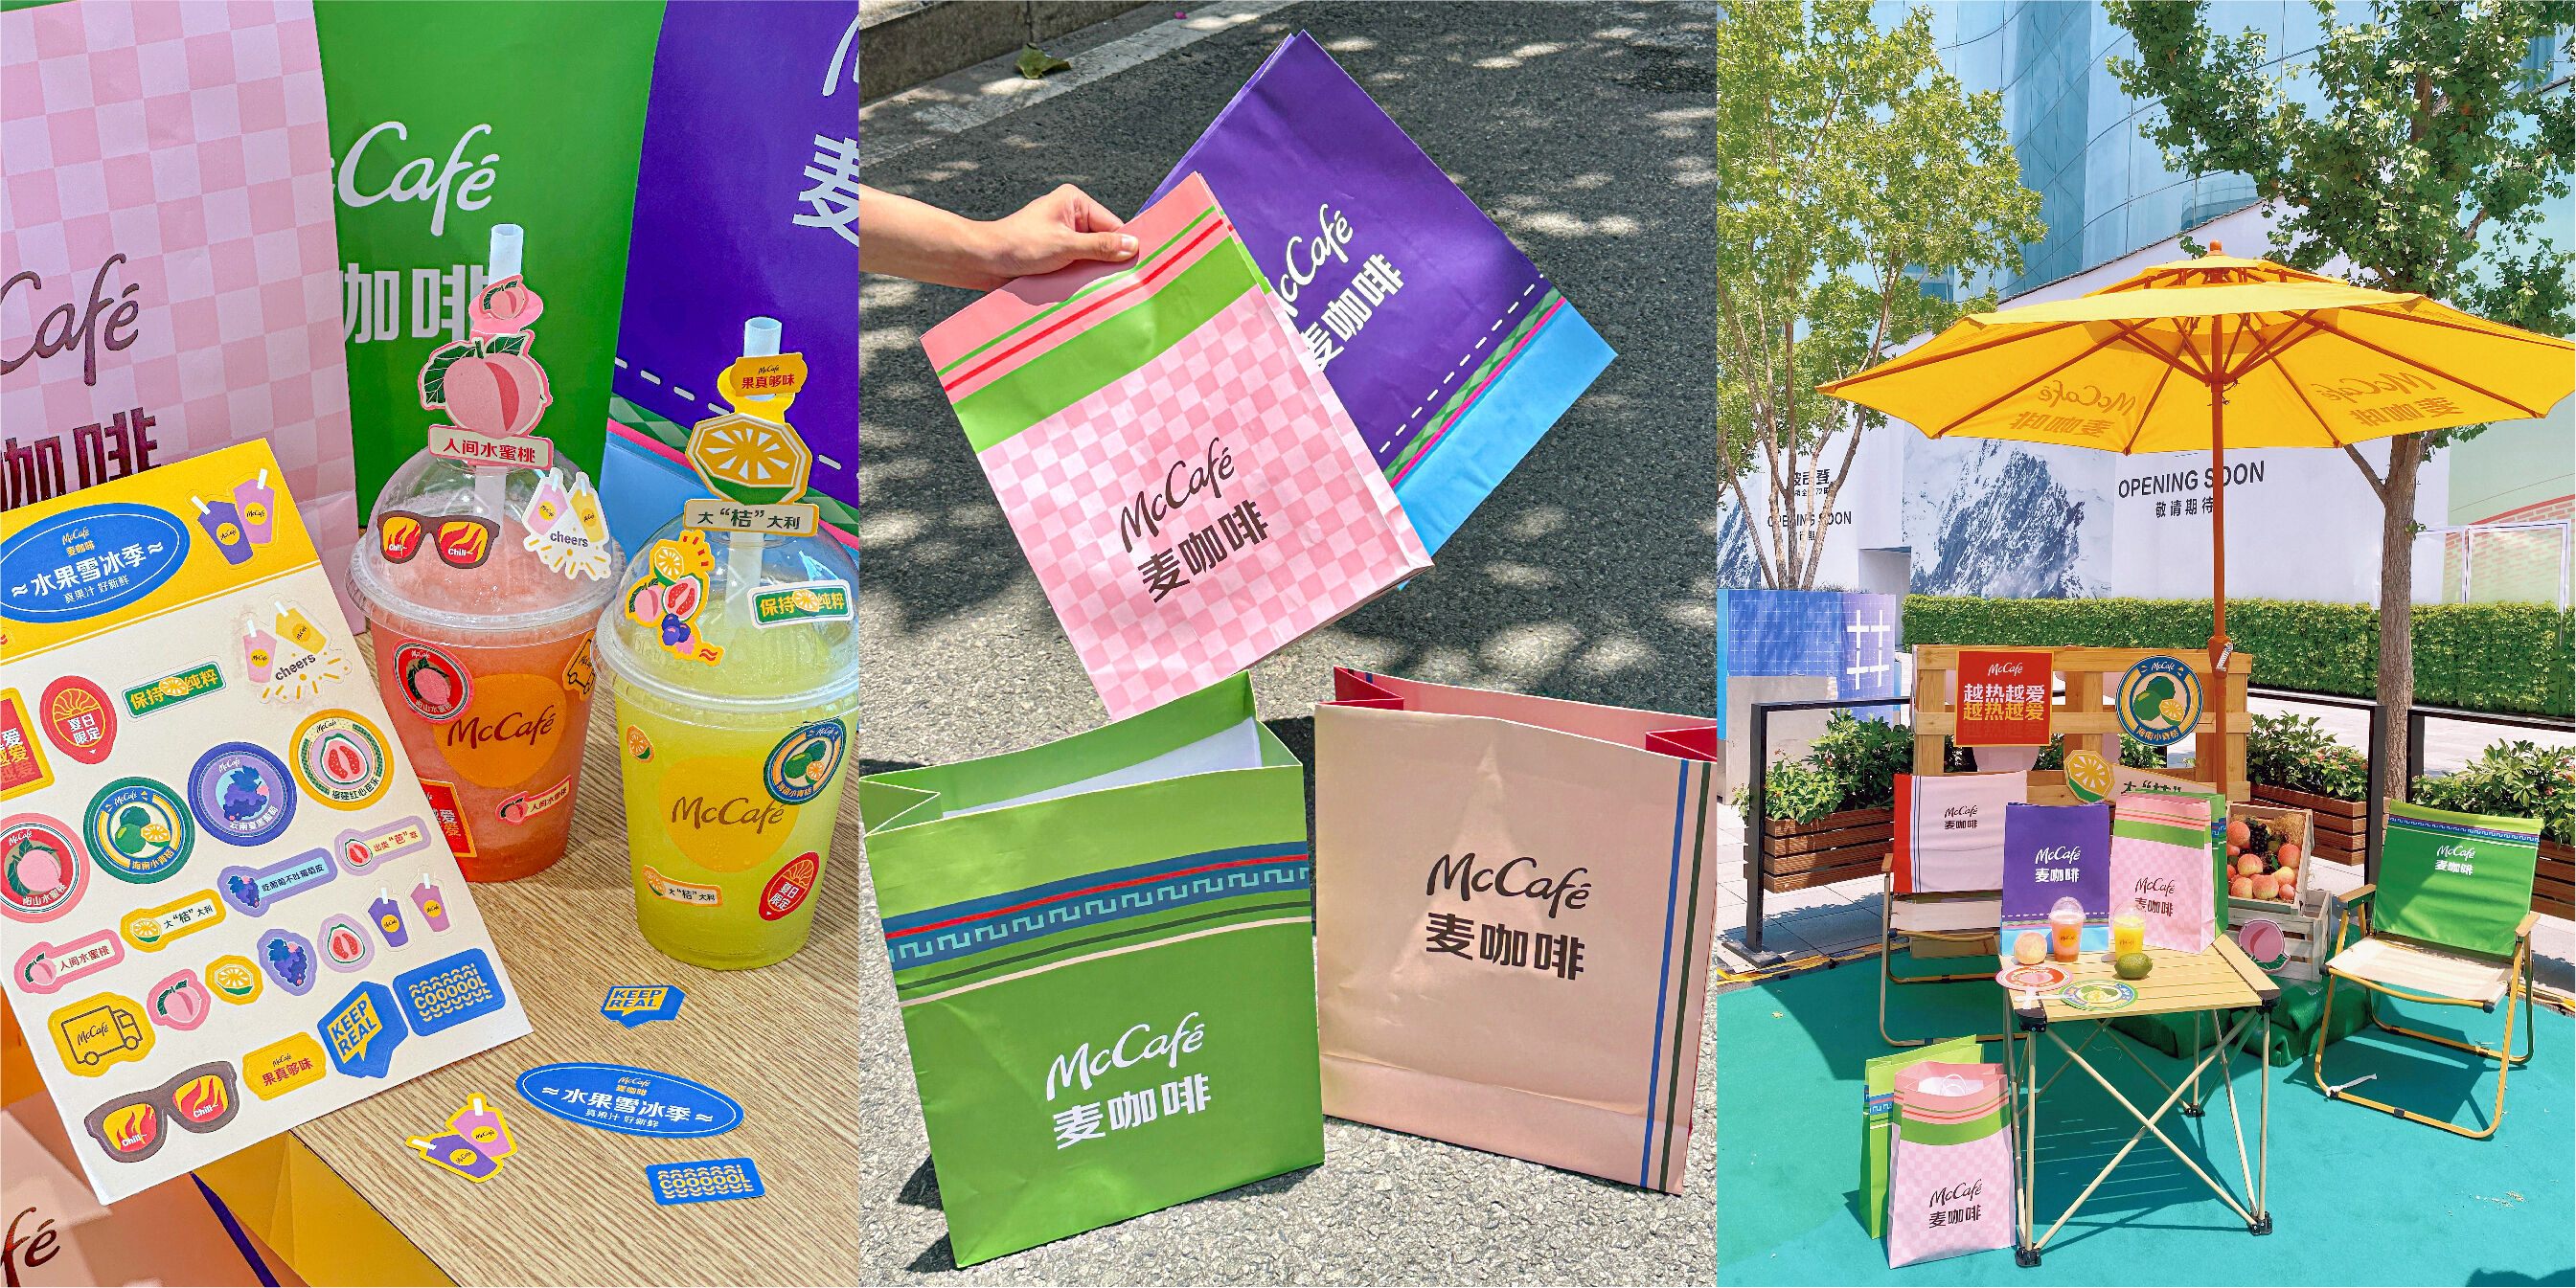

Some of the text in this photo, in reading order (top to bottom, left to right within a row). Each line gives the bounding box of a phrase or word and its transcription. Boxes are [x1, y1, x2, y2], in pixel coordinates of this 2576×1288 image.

[331, 122, 499, 236] Café
[339, 263, 490, 343] 咖啡
[741, 373, 795, 390] 果真够味
[444, 439, 536, 463] 人间水蜜桃
[1120, 437, 1236, 553] McCafé
[2118, 469, 2199, 498] OPENING
[1819, 511, 1852, 525] OON
[2155, 496, 2213, 518] 敬请期待
[550, 531, 589, 548] cheers
[1137, 499, 1269, 602] 麦咖啡
[31, 543, 147, 597] 水果雪冰季
[760, 596, 795, 617] 保持
[275, 653, 316, 681] cheers
[1988, 662, 2023, 676] McCafé
[1963, 683, 2045, 703] 越热越爱
[1963, 701, 2044, 721] 越热越爱
[73, 727, 103, 745] 限定
[447, 705, 557, 750] McCafé
[672, 796, 785, 834] McCafé
[1945, 804, 1977, 818] McCafé
[1944, 820, 1978, 829] 麦咖啡
[2035, 846, 2081, 864] McCafé
[2437, 846, 2475, 861] McCafé
[1426, 852, 1590, 918] McCafé
[2035, 868, 2080, 883] 麦咖啡
[2134, 877, 2175, 896] McCafé
[59, 945, 110, 972] 人间水蜜桃
[1425, 912, 1585, 981] 麦咖啡
[609, 999, 657, 1007] REAL
[613, 989, 663, 999] KEEP
[331, 999, 368, 1041] KEEP
[77, 1021, 109, 1046] McCafé
[337, 1017, 377, 1057] REAL
[1046, 1011, 1205, 1101] McCafé
[262, 1057, 314, 1087] 果真够味
[561, 1088, 692, 1122] 水果雪冰季
[1053, 1073, 1212, 1149] 麦咖啡
[1929, 1179, 1982, 1209] McCafé
[1928, 1205, 1982, 1229] 麦咖啡
